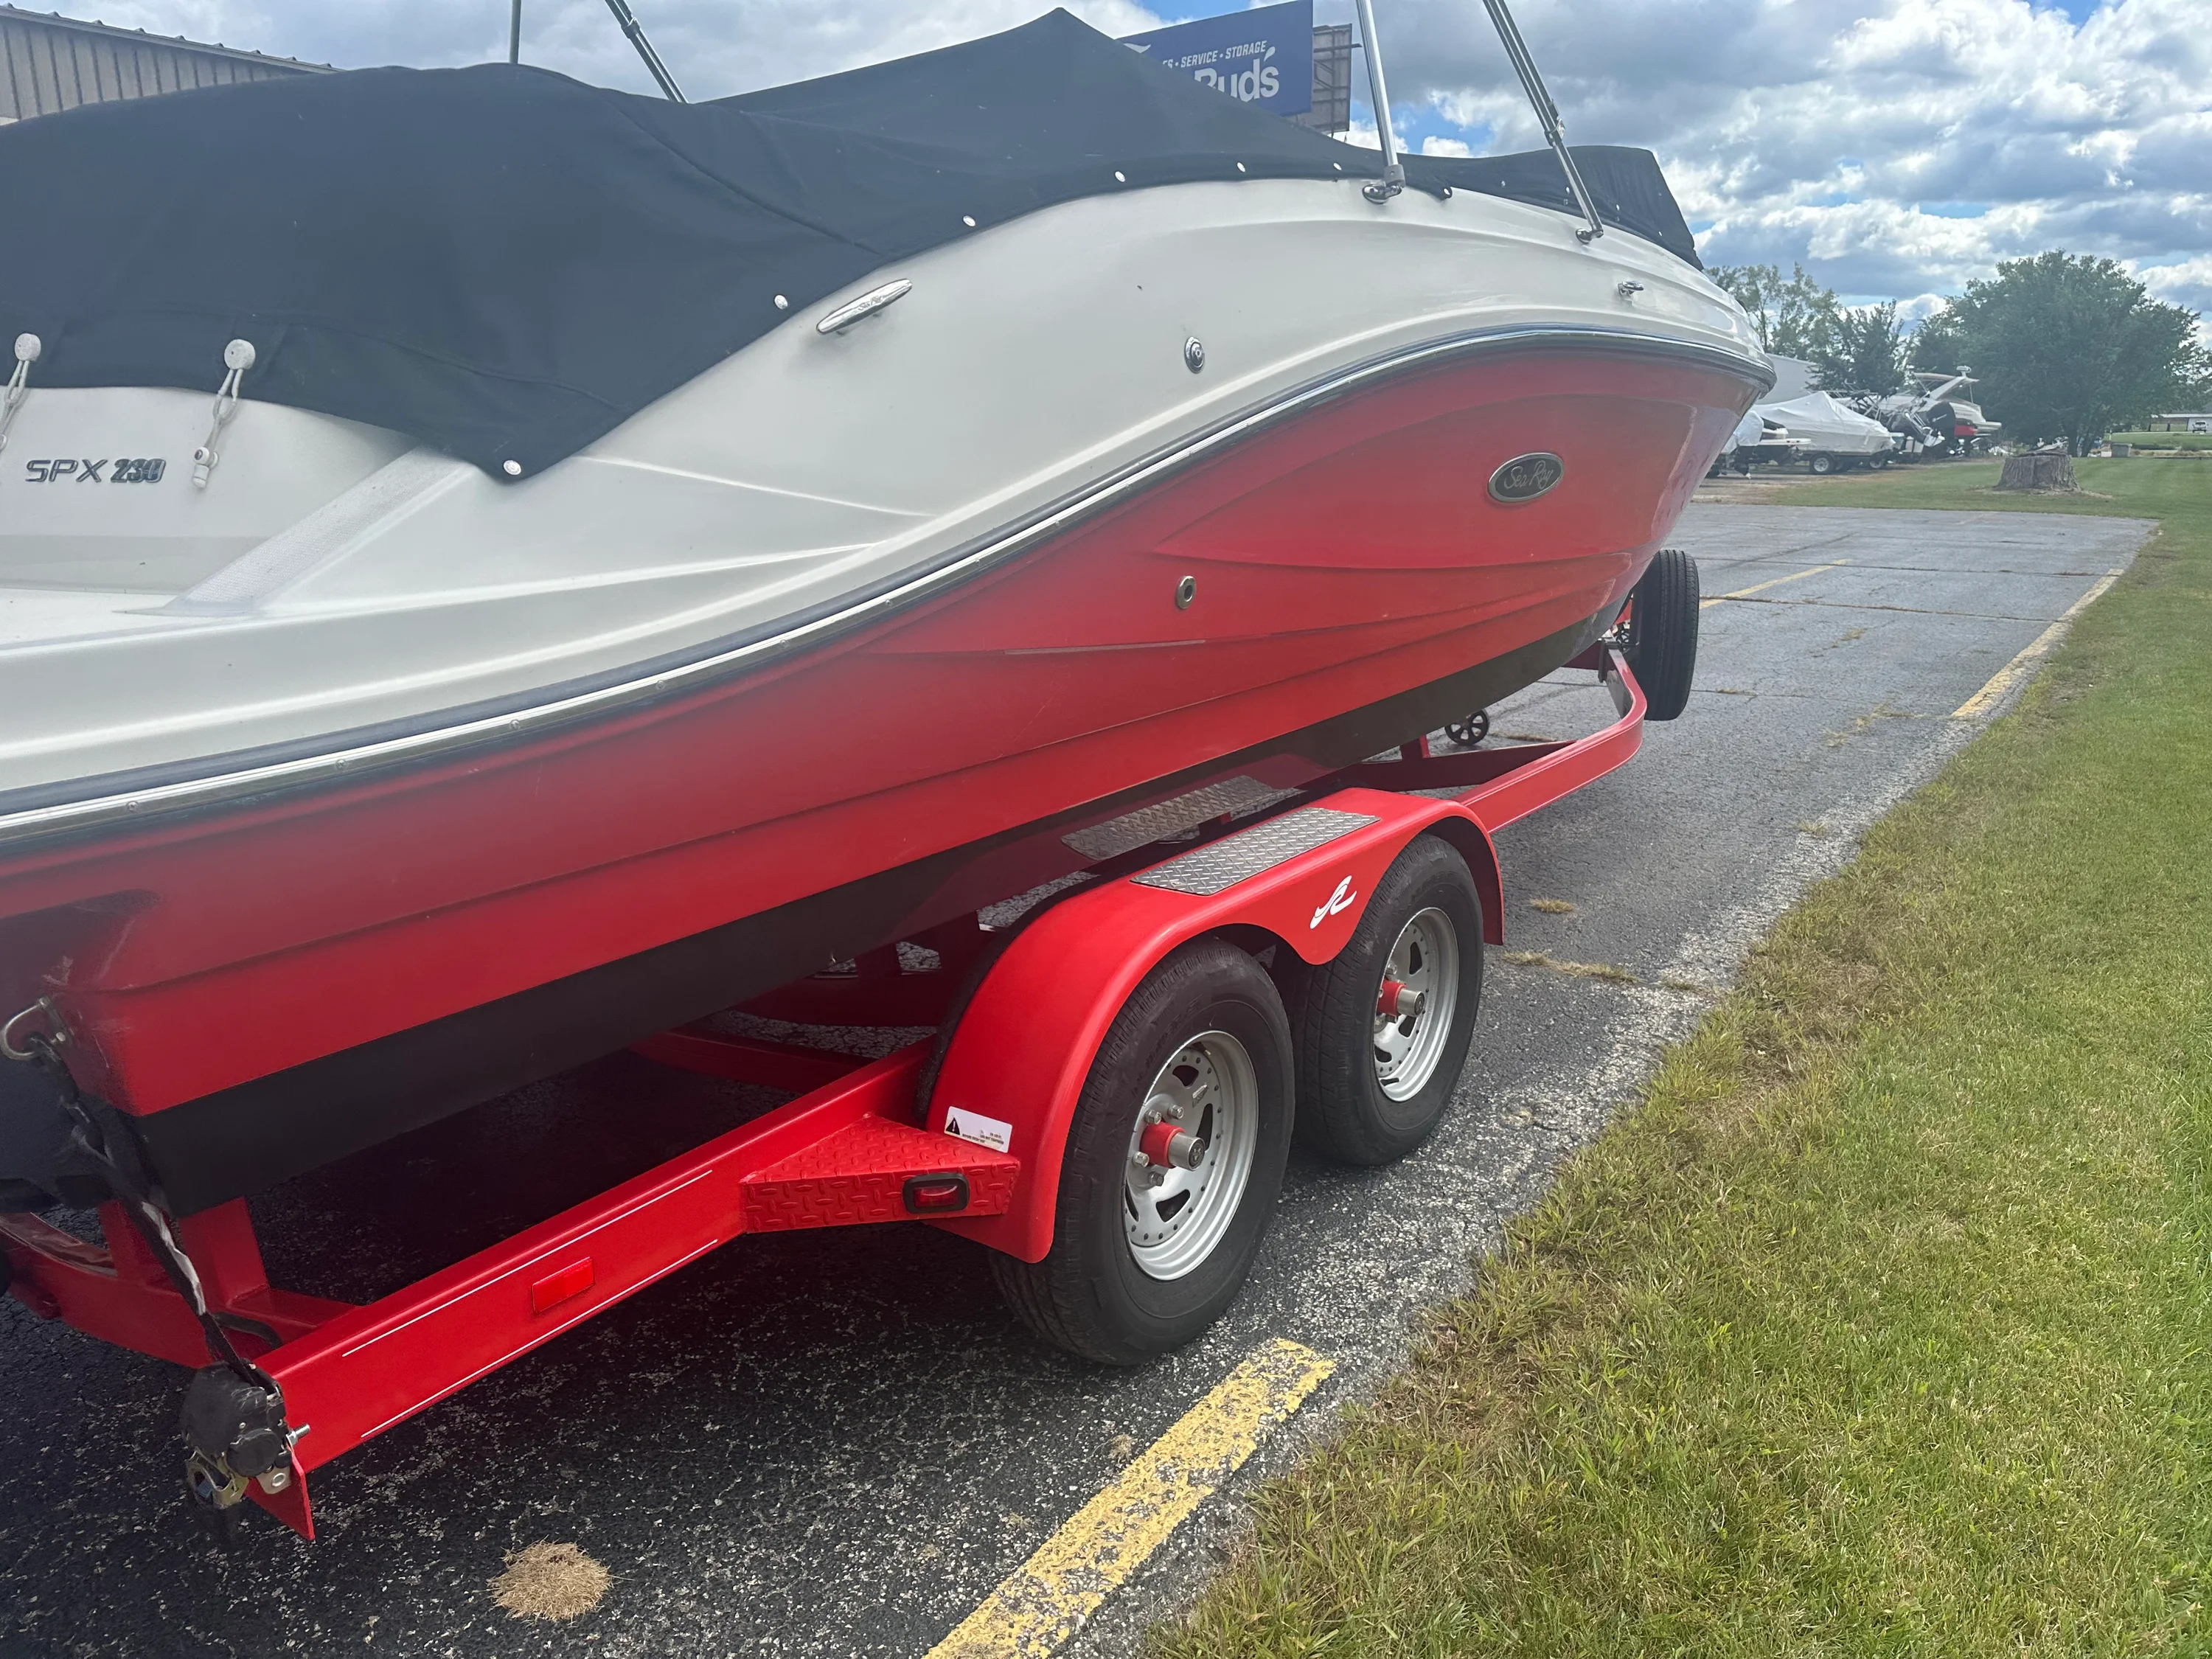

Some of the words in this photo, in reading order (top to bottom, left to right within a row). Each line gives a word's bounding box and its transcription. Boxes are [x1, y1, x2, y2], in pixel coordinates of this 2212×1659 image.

[1180, 50, 1218, 68] SERVICE
[1225, 40, 1267, 60] STORAGE
[25, 459, 108, 483] SPX
[110, 458, 167, 484] 230
[1504, 465, 1528, 490] Sea
[1528, 459, 1554, 490] Ray
